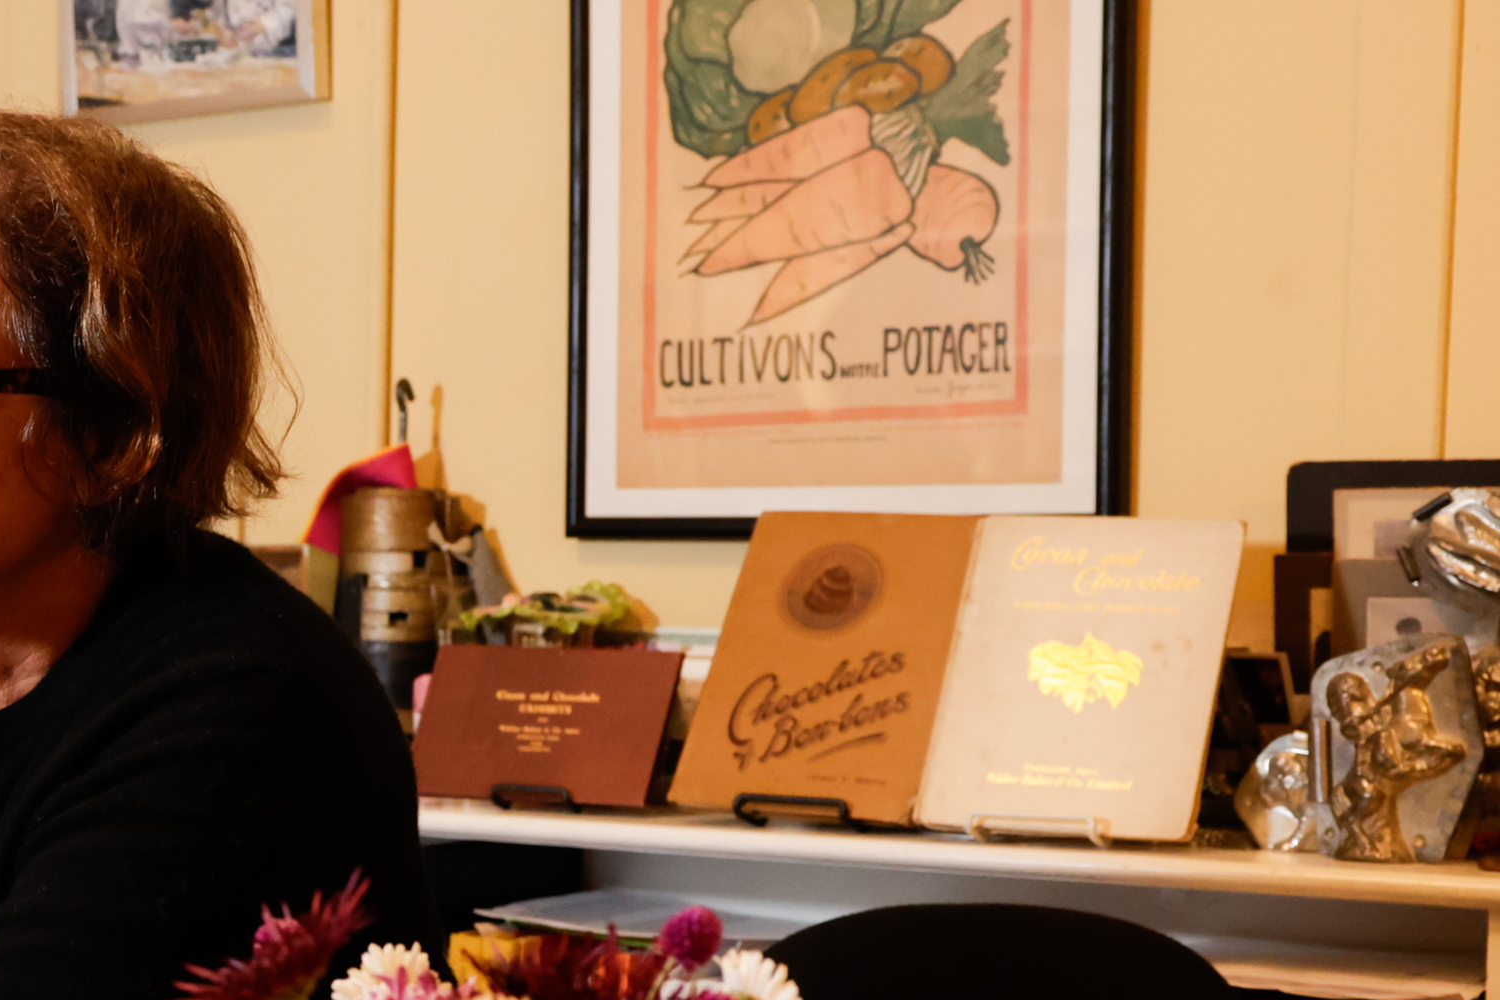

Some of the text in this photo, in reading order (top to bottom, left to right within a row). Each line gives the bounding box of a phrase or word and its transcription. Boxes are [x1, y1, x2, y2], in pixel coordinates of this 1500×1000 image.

[659, 330, 838, 388] CULTIVONS
[882, 321, 1012, 378] POTAGER
[1072, 565, 1201, 596] Chocolate
[728, 650, 906, 746] Chocolates
